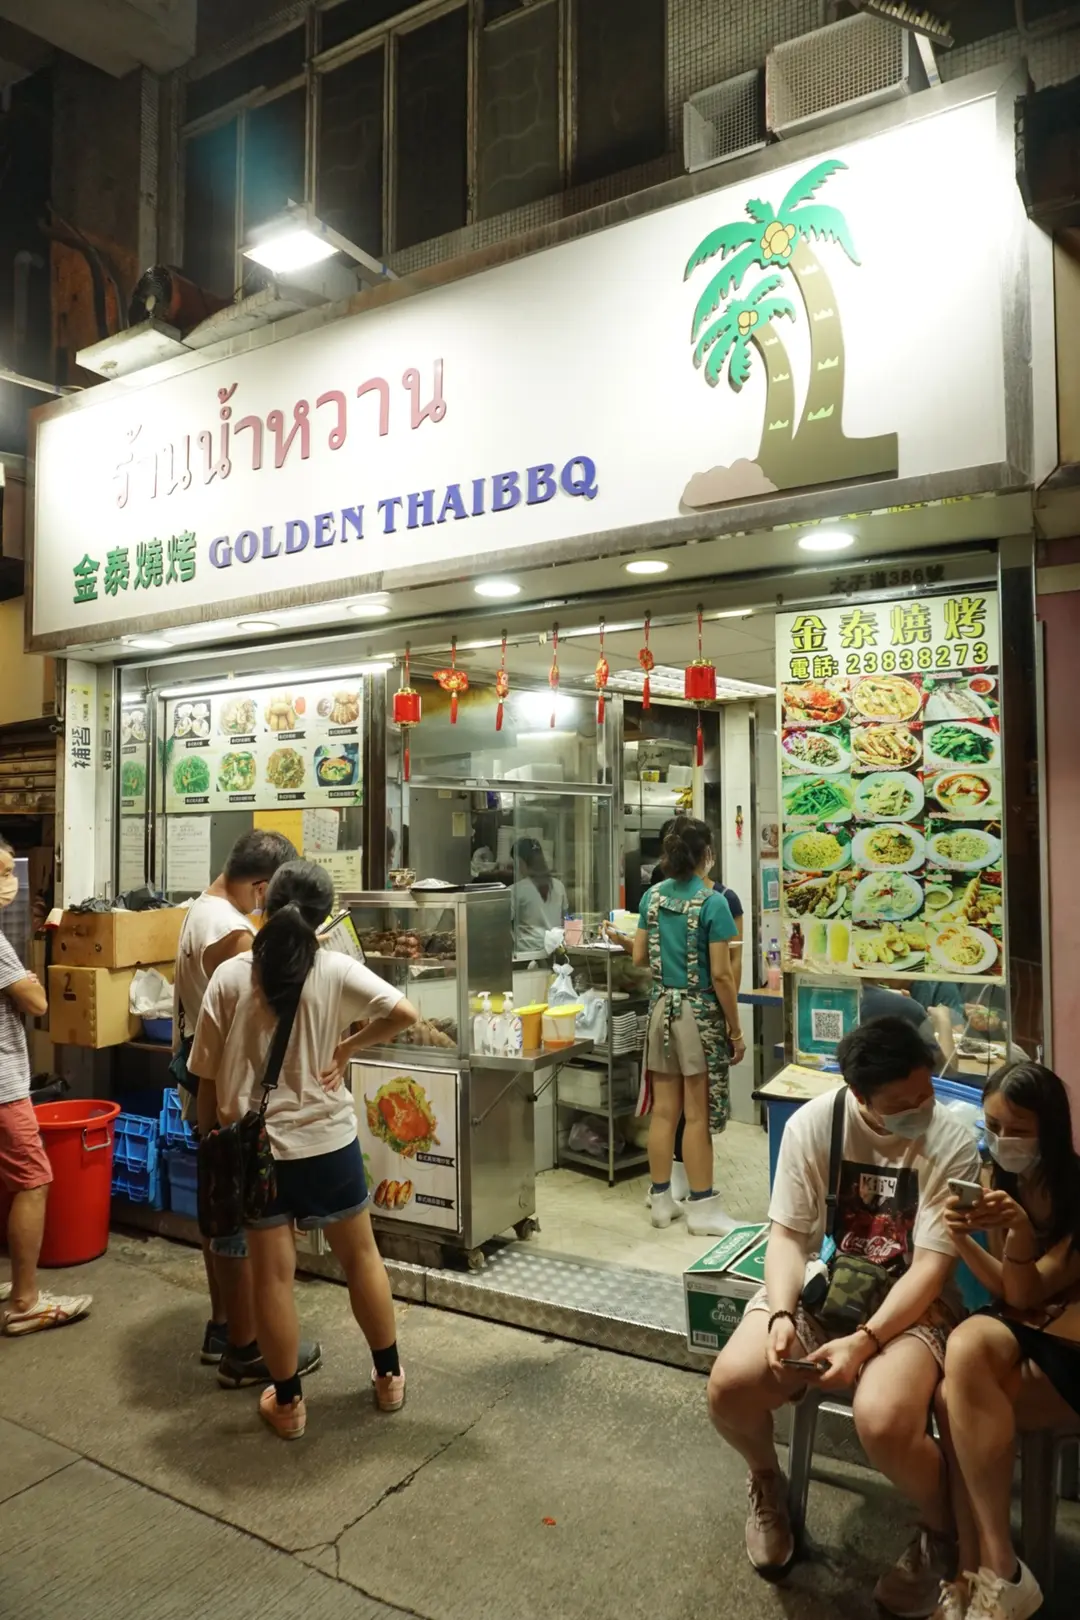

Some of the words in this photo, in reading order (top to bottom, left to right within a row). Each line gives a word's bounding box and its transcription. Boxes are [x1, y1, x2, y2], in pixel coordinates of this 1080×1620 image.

[208, 504, 365, 569] GOLDEN
[376, 455, 599, 534] THAIBBQ
[72, 529, 197, 604] 金泰燒烤
[789, 596, 986, 653] 金泰燒烤
[845, 640, 989, 676] 23838273
